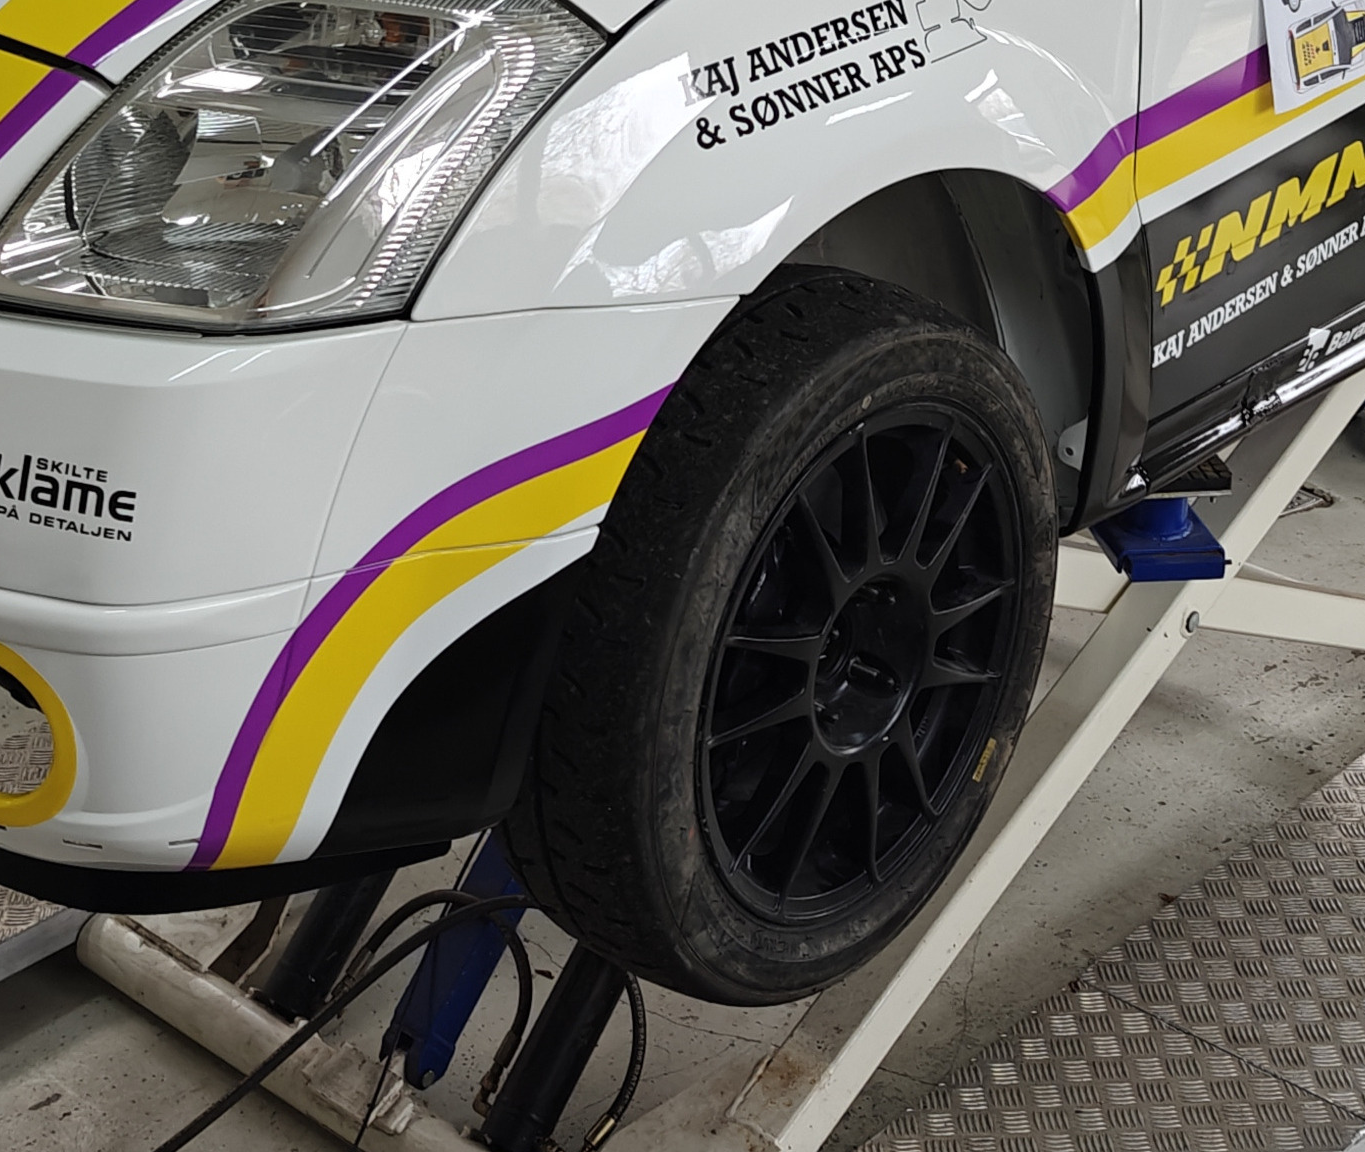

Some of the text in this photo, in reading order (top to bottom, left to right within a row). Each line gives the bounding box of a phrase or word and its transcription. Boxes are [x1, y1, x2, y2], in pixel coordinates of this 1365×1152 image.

[678, 56, 740, 107] KAJ
[695, 38, 926, 149] & SØNNER APS
[1152, 329, 1185, 368] KAJ
[1186, 272, 1278, 348] ANDERSEN
[1281, 264, 1294, 288] &
[1296, 222, 1360, 279] SØNNER
[36, 457, 109, 483] SKILTE
[29, 512, 133, 542] DETALJEN
